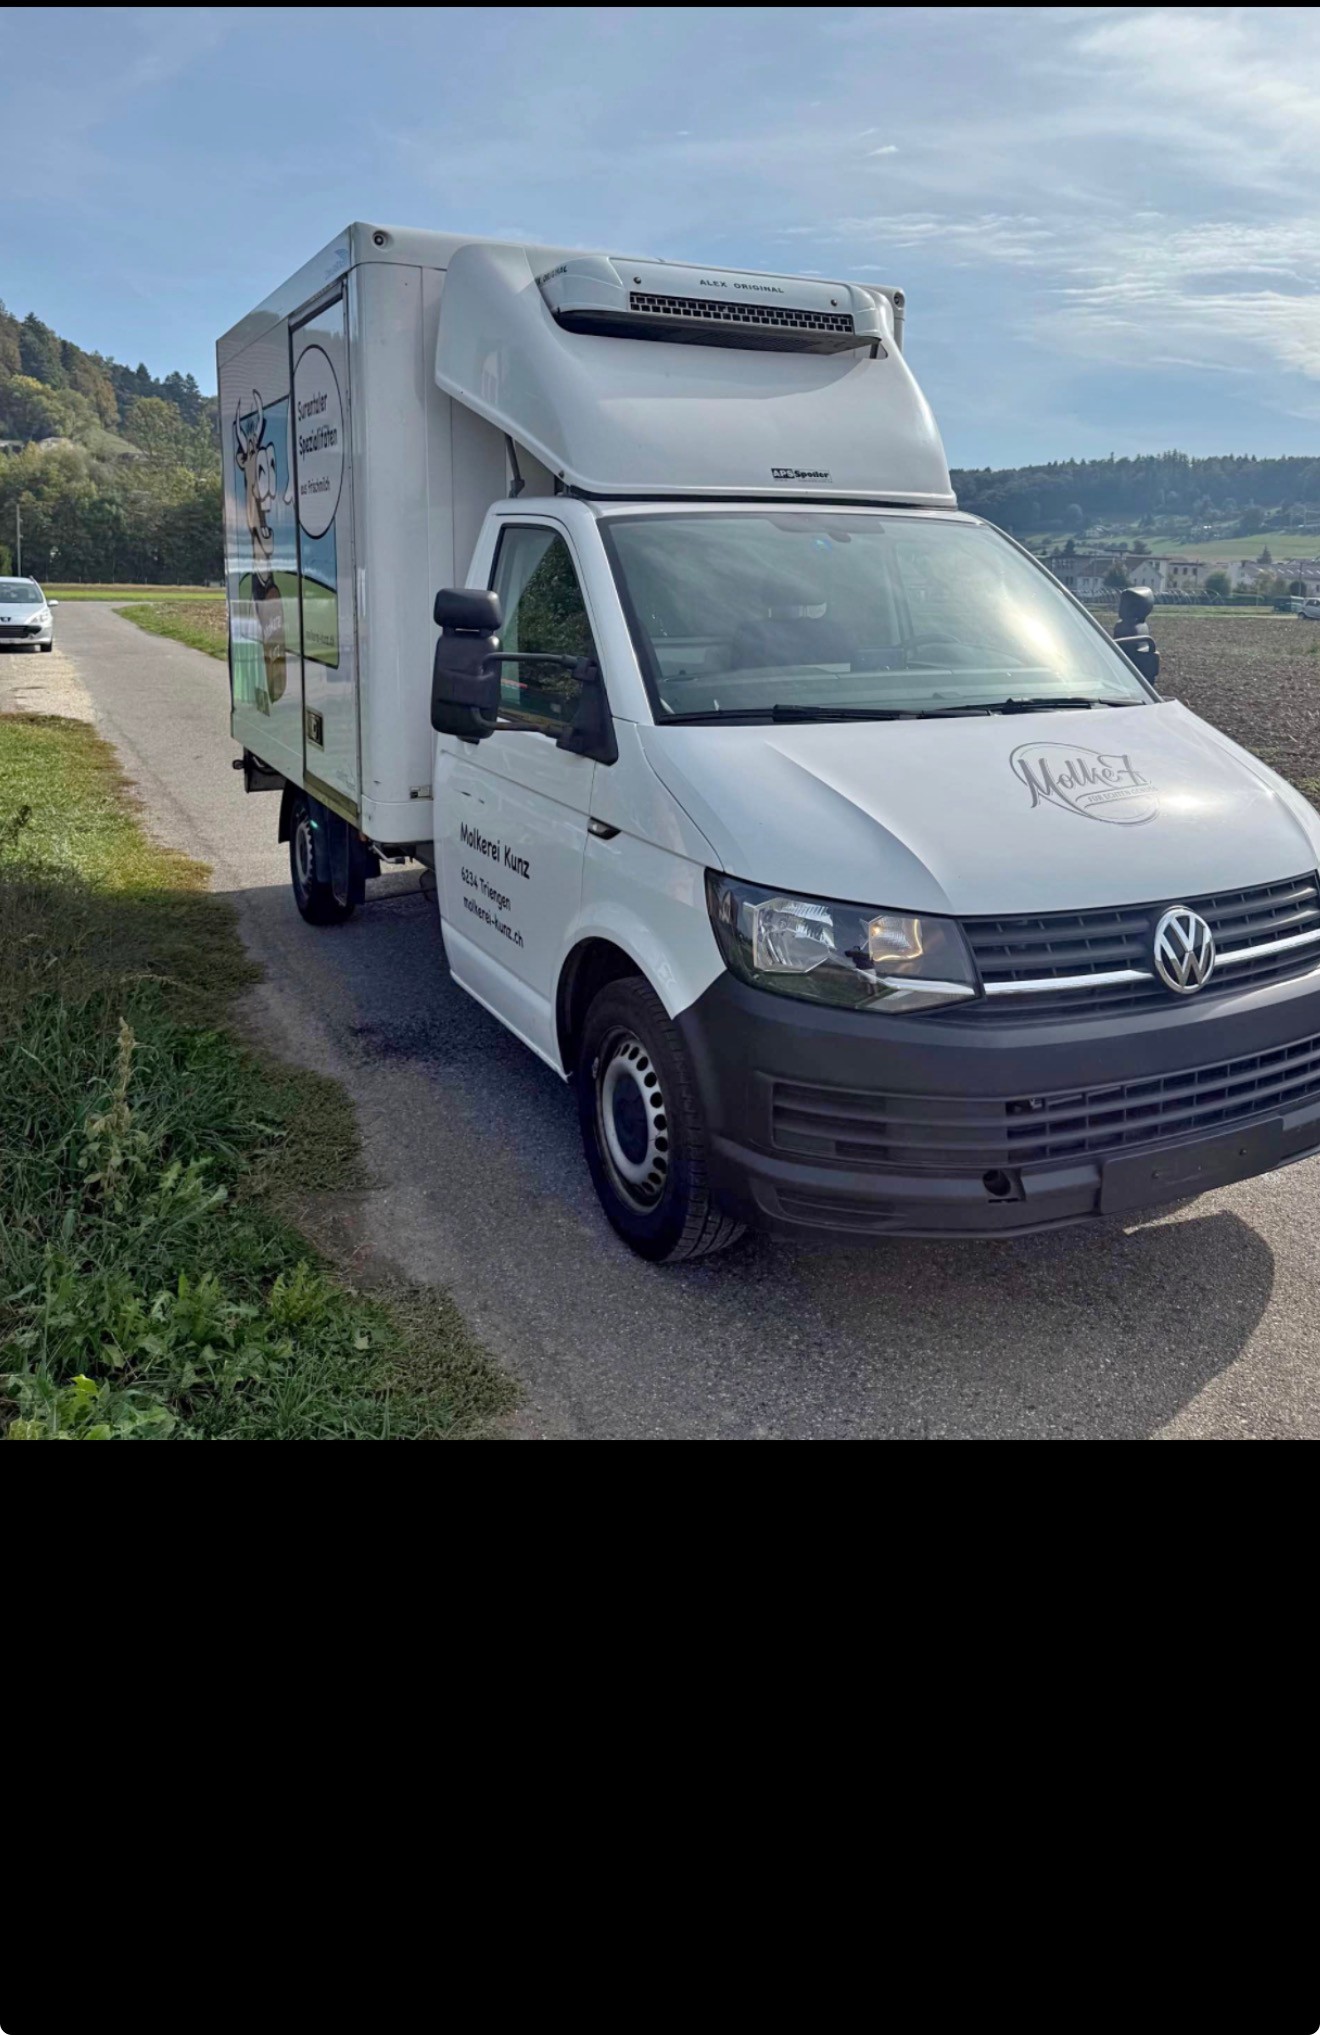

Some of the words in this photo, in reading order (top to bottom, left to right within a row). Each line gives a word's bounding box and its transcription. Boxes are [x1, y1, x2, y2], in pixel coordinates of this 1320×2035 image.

[699, 279, 728, 288] ALEX
[733, 283, 784, 294] ORIGINAL
[771, 468, 795, 479] APS
[459, 821, 500, 863] Molkerei
[503, 844, 531, 880] Kunz
[461, 866, 478, 889] 6234
[479, 877, 512, 912] Triengen
[463, 896, 525, 949] molkerei-kunz.ch
[1154, 906, 1216, 993] VW
